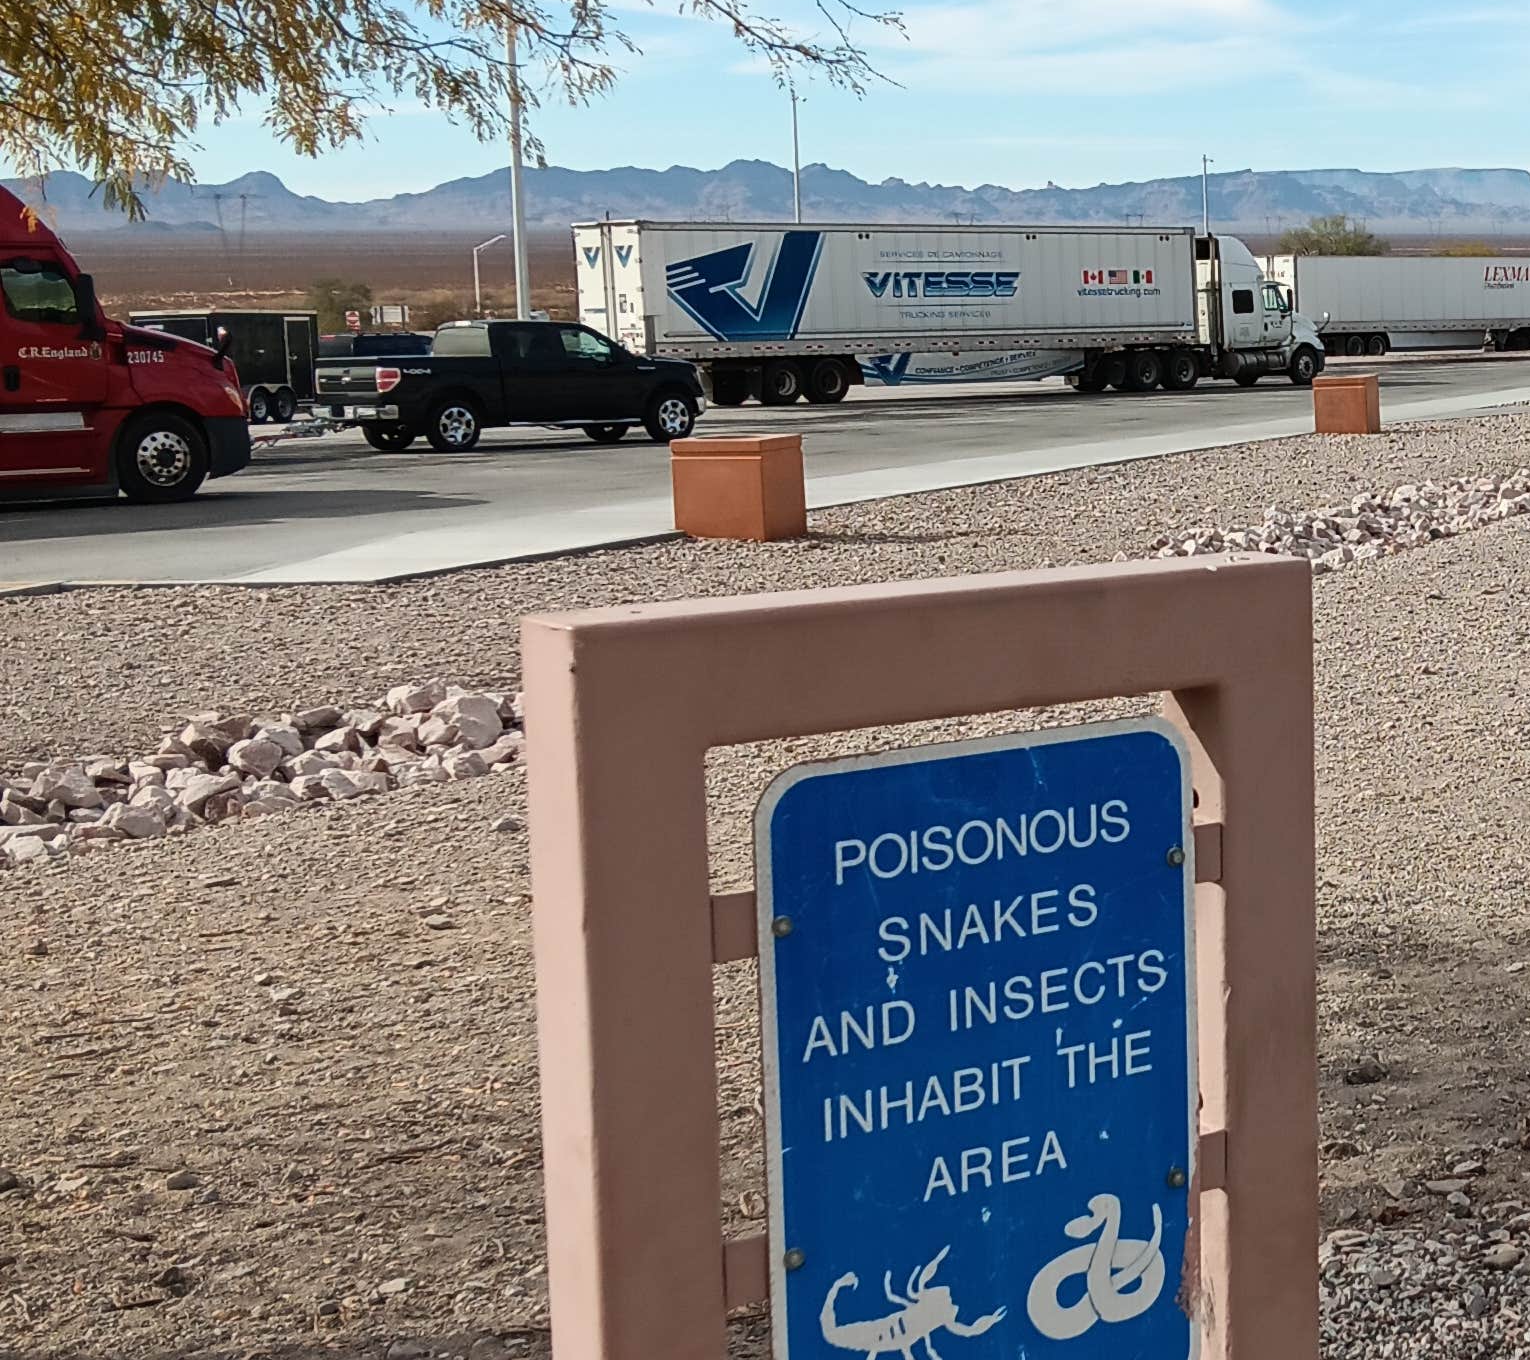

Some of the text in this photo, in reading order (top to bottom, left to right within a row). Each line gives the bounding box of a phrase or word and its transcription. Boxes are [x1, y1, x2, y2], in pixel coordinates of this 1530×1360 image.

[861, 272, 1022, 298] VITESSE
[1077, 286, 1161, 298] vitessetrucking.com
[127, 351, 165, 365] 230745
[835, 799, 1131, 885] POISONOUS
[877, 883, 1099, 962] SNAKES
[803, 949, 1168, 1063] AND INSECTS
[824, 1030, 1153, 1142] INHABIT THE
[923, 1130, 1068, 1202] AREA
